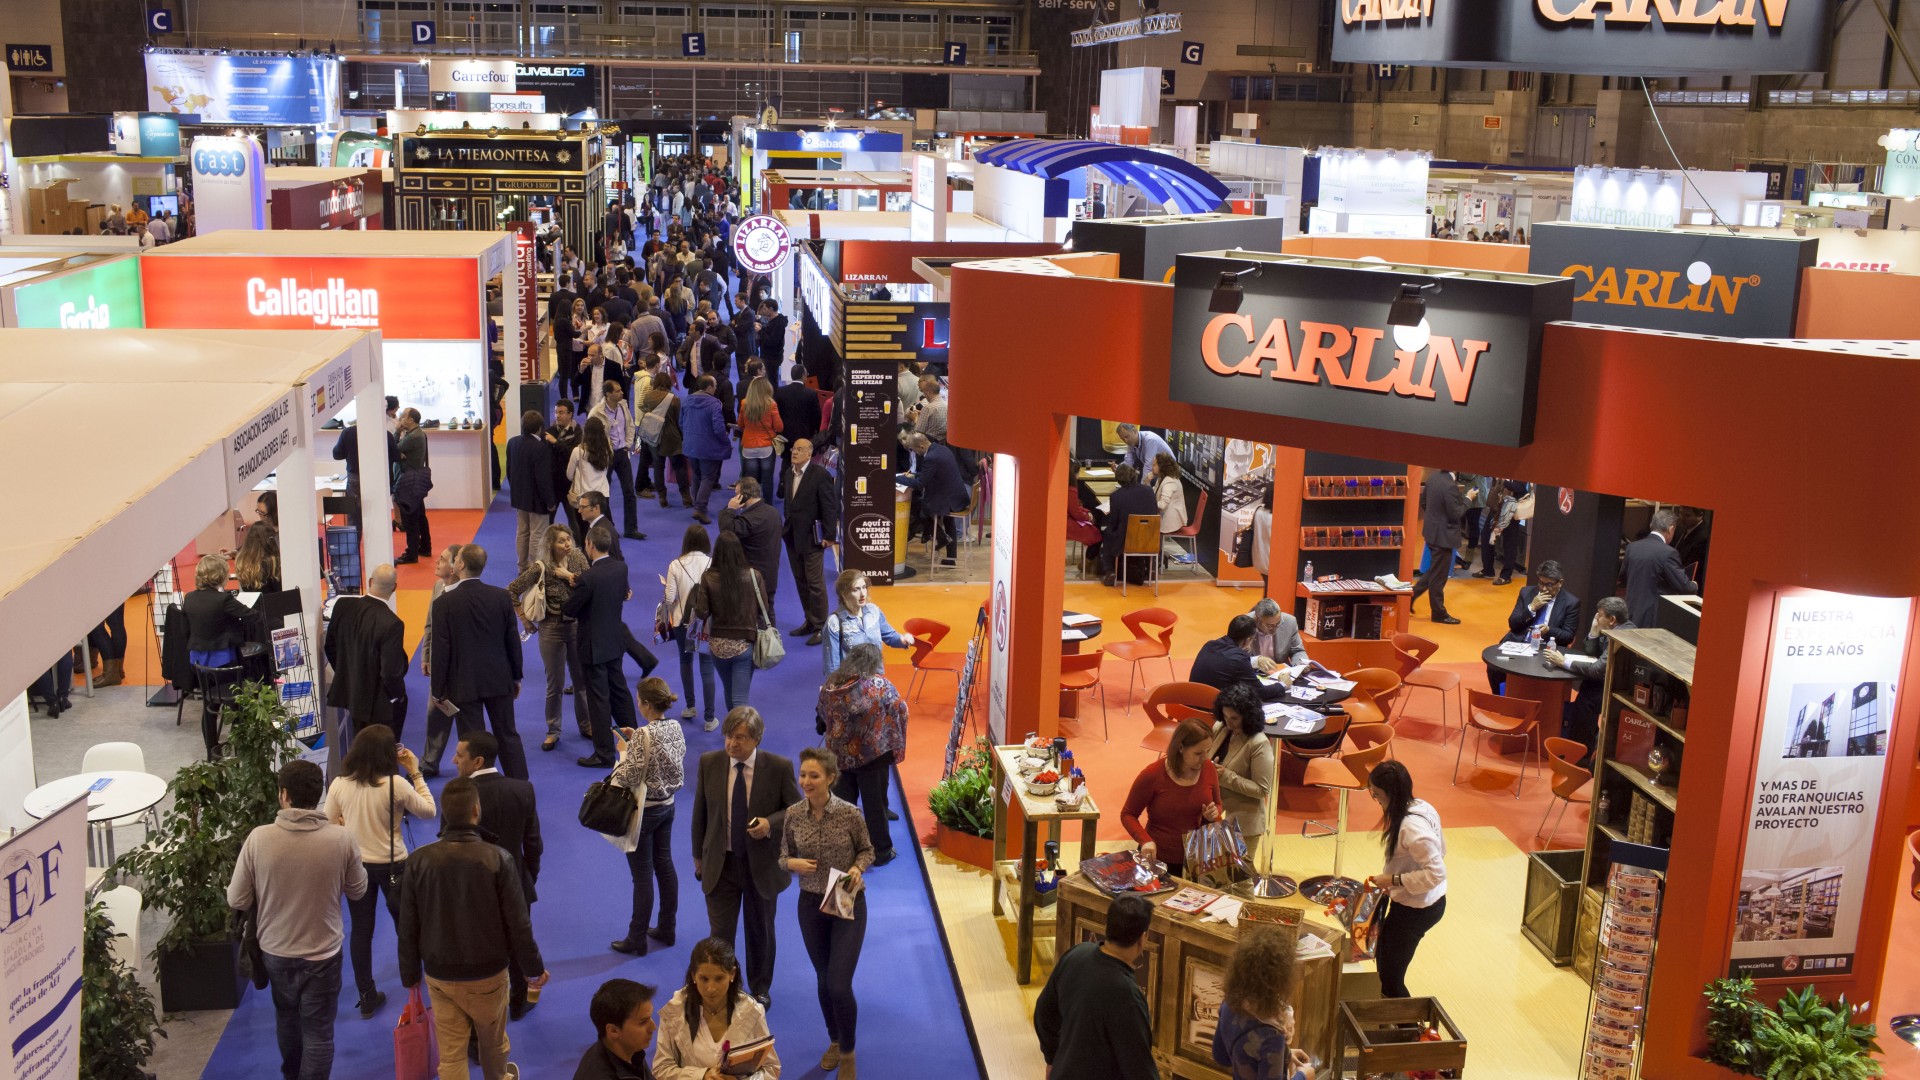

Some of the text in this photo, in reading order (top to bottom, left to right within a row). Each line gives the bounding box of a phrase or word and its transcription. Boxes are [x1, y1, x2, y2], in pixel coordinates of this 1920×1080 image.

[153, 13, 167, 29] C
[417, 25, 431, 41] D
[689, 37, 700, 53] E
[949, 46, 961, 62] F
[1185, 45, 1200, 62] G
[452, 70, 510, 82] Carrefour
[1378, 63, 1391, 77] H
[490, 102, 532, 110] consulta
[198, 151, 241, 171] f.a.s.t.
[438, 147, 550, 162] LA PIEMONTESA
[504, 181, 533, 189] GRUPO
[1576, 202, 1674, 228] Extremadura
[736, 218, 789, 246] LIZARRAN
[261, 403, 284, 433] ESPAÑOLA
[283, 399, 289, 418] DE
[238, 437, 279, 484] FRANQUICIADORES
[862, 518, 881, 528] AQUÍ
[1324, 618, 1335, 628] A4
[1791, 610, 1855, 622] NUESTRA
[1784, 625, 1897, 641] EXPEENCIA
[1787, 641, 1864, 657] DE 25 AÑOS
[1622, 733, 1632, 741] A4
[1760, 780, 1817, 791] Y MAS DE
[1758, 791, 1864, 804] 500 FRANQUICIAS
[1756, 804, 1864, 817] AVALAN NUESTRO
[1754, 818, 1819, 830] PROYECTO
[0, 840, 63, 933] EF
[9, 993, 22, 1011] que
[23, 983, 31, 997] la
[33, 957, 67, 990] franquicia
[16, 996, 37, 1014] socia
[37, 986, 48, 1000] de
[48, 974, 62, 992] AEF
